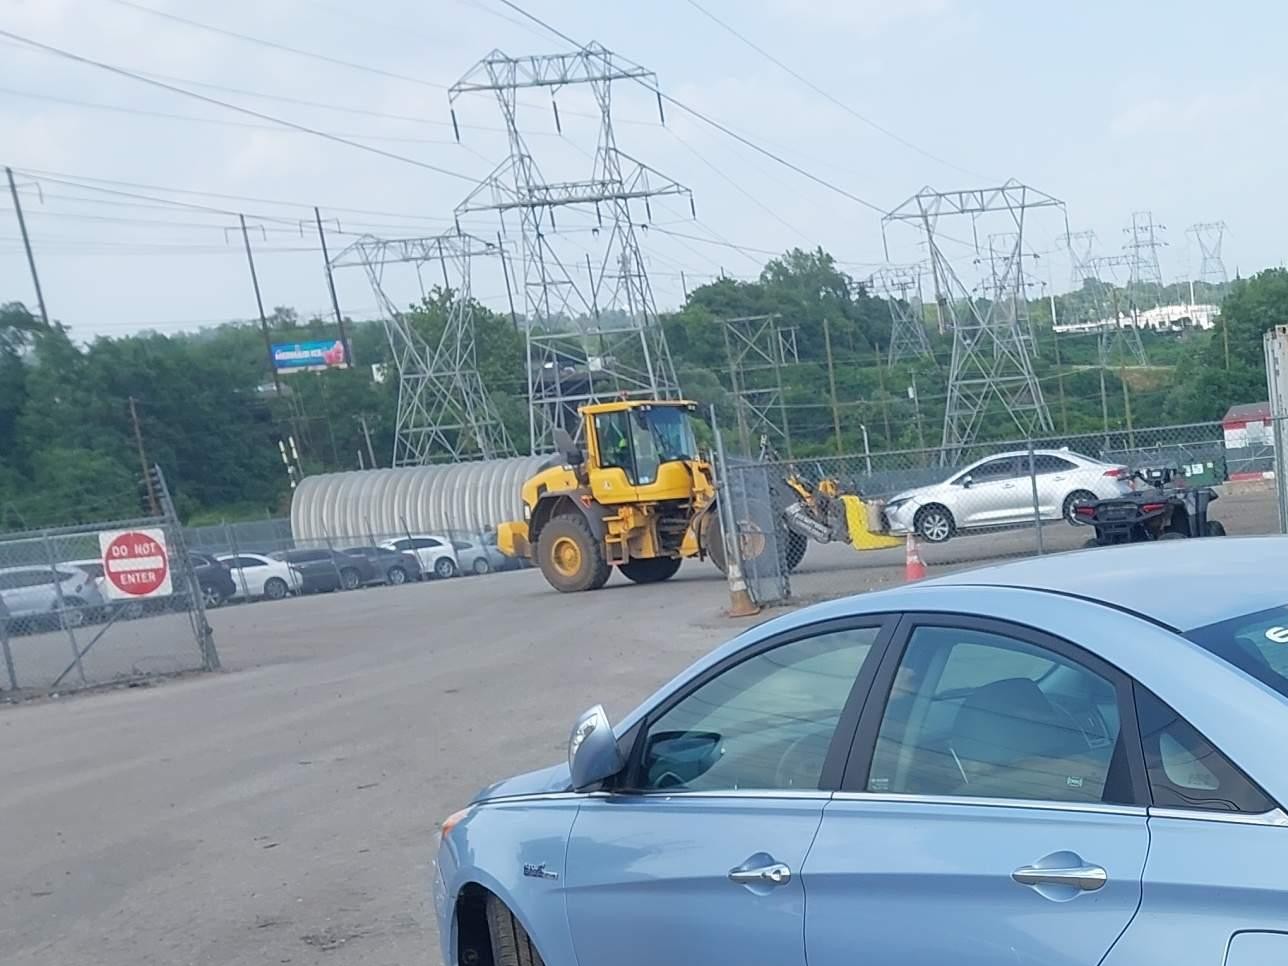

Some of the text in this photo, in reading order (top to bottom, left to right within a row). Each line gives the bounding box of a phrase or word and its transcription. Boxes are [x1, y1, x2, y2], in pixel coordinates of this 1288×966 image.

[112, 542, 156, 557] DO NOT
[120, 571, 156, 585] ENTER
